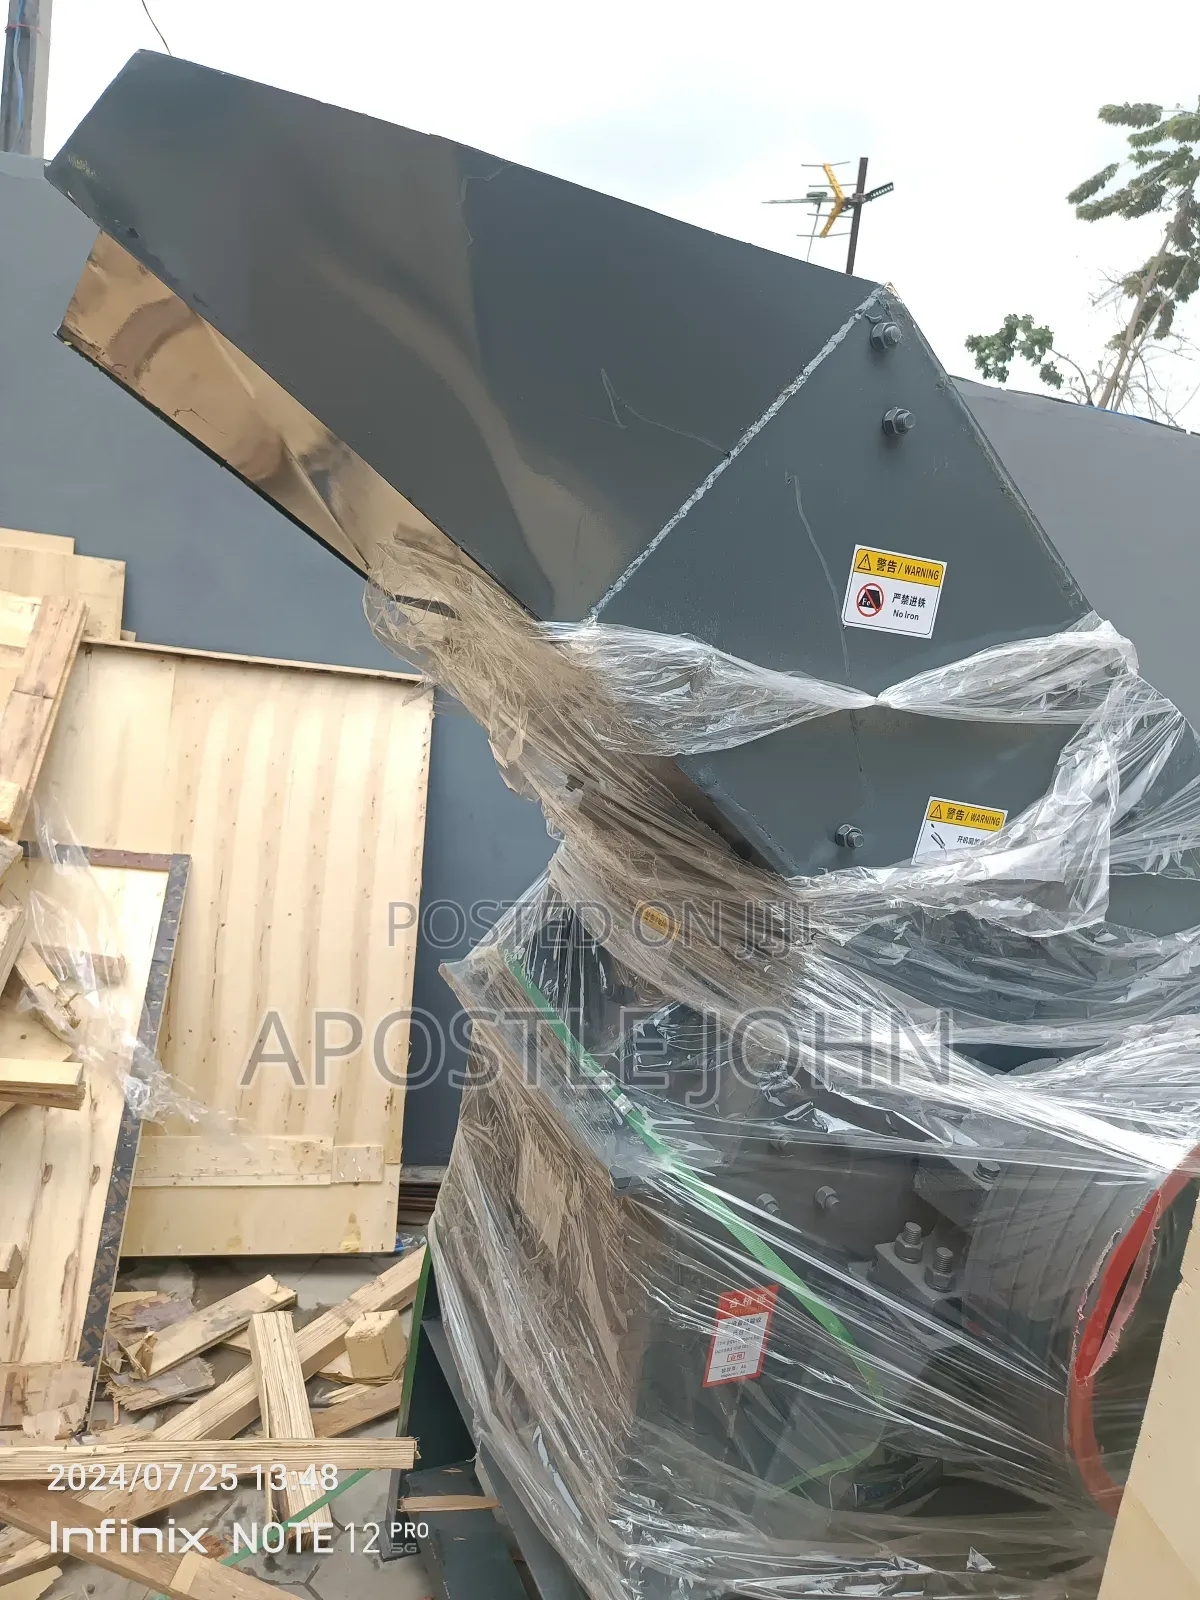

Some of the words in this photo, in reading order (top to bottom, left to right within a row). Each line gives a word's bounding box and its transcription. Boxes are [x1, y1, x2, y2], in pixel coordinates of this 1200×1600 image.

[876, 557, 898, 574] 警告
[904, 563, 940, 581] WARNING
[892, 592, 927, 609] 严禁进铁
[892, 609, 904, 619] No
[946, 807, 965, 821] 警告
[970, 814, 1001, 827] WARNING
